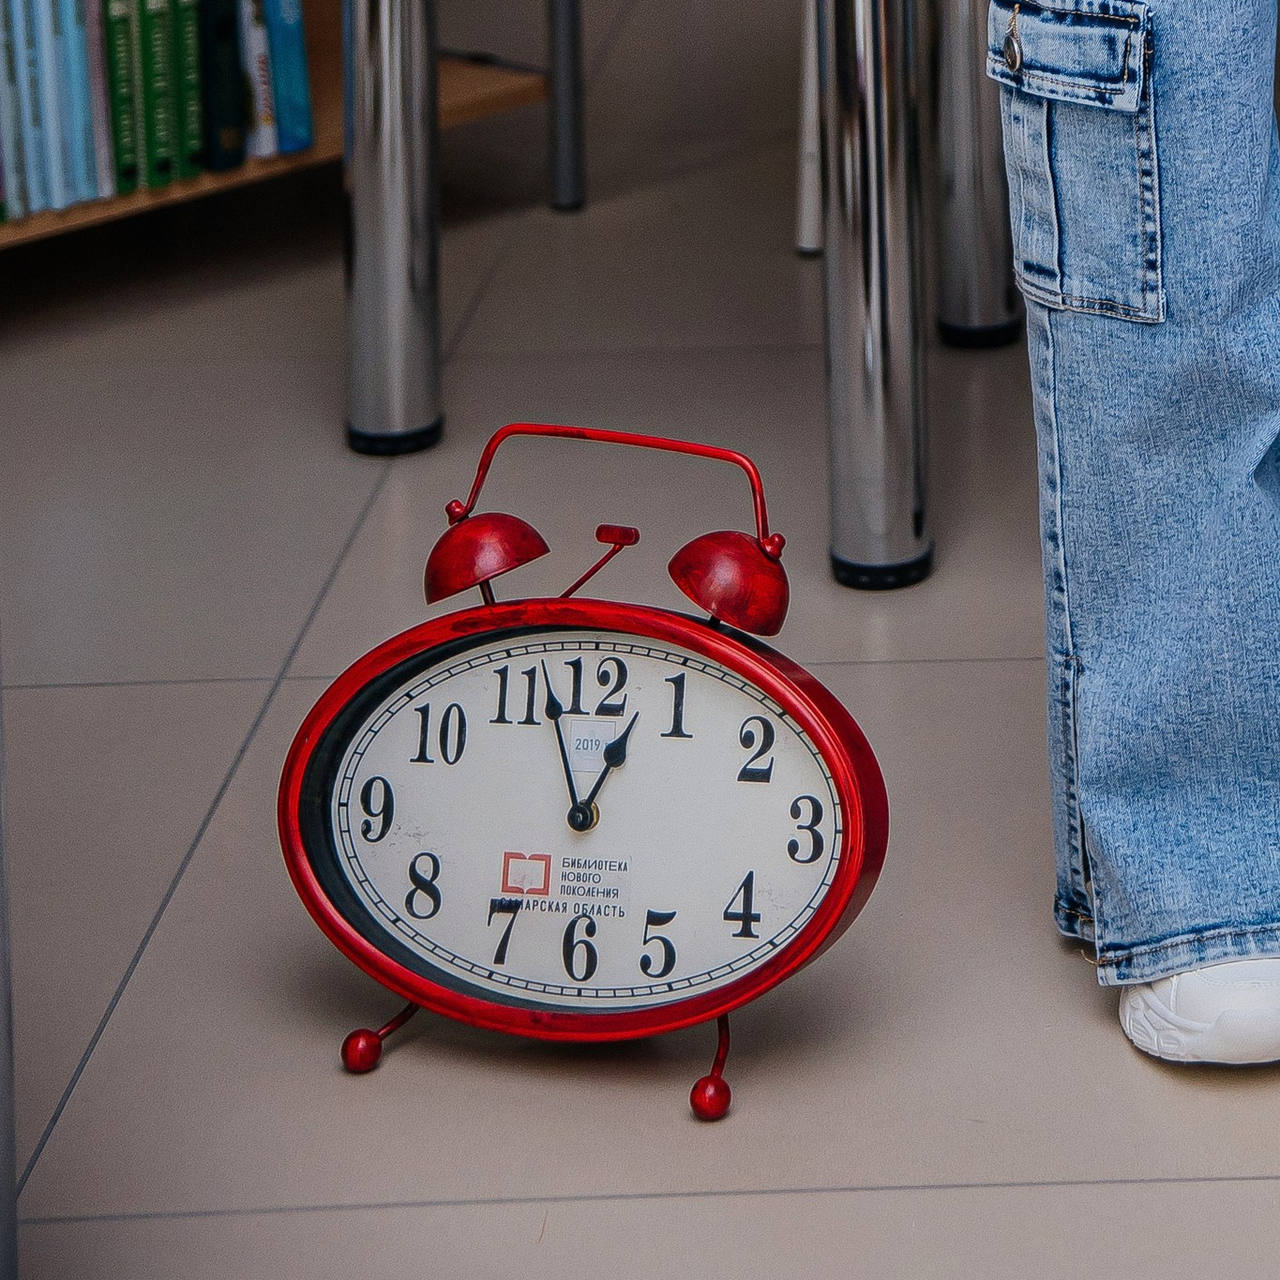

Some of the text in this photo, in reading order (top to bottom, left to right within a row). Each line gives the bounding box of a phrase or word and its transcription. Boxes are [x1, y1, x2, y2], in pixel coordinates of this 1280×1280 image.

[489, 665, 542, 726] 11
[562, 656, 628, 717] 12
[660, 672, 693, 738] 1
[410, 703, 468, 766] 10
[574, 738, 601, 751] 2019
[738, 716, 775, 783] 2
[360, 776, 395, 843] 9
[787, 795, 824, 864] 3
[405, 852, 441, 920] 8
[560, 884, 619, 899] ПОКОЛЕНИЯ
[561, 871, 602, 884] НОВОГО
[562, 857, 628, 872] БИБЛИОТЕКА
[487, 897, 522, 966] 7
[498, 897, 625, 918] АРСКАЯ ОБЛАСТЬ
[723, 871, 762, 938] 4
[563, 913, 599, 983] 6
[640, 910, 676, 979] 5
